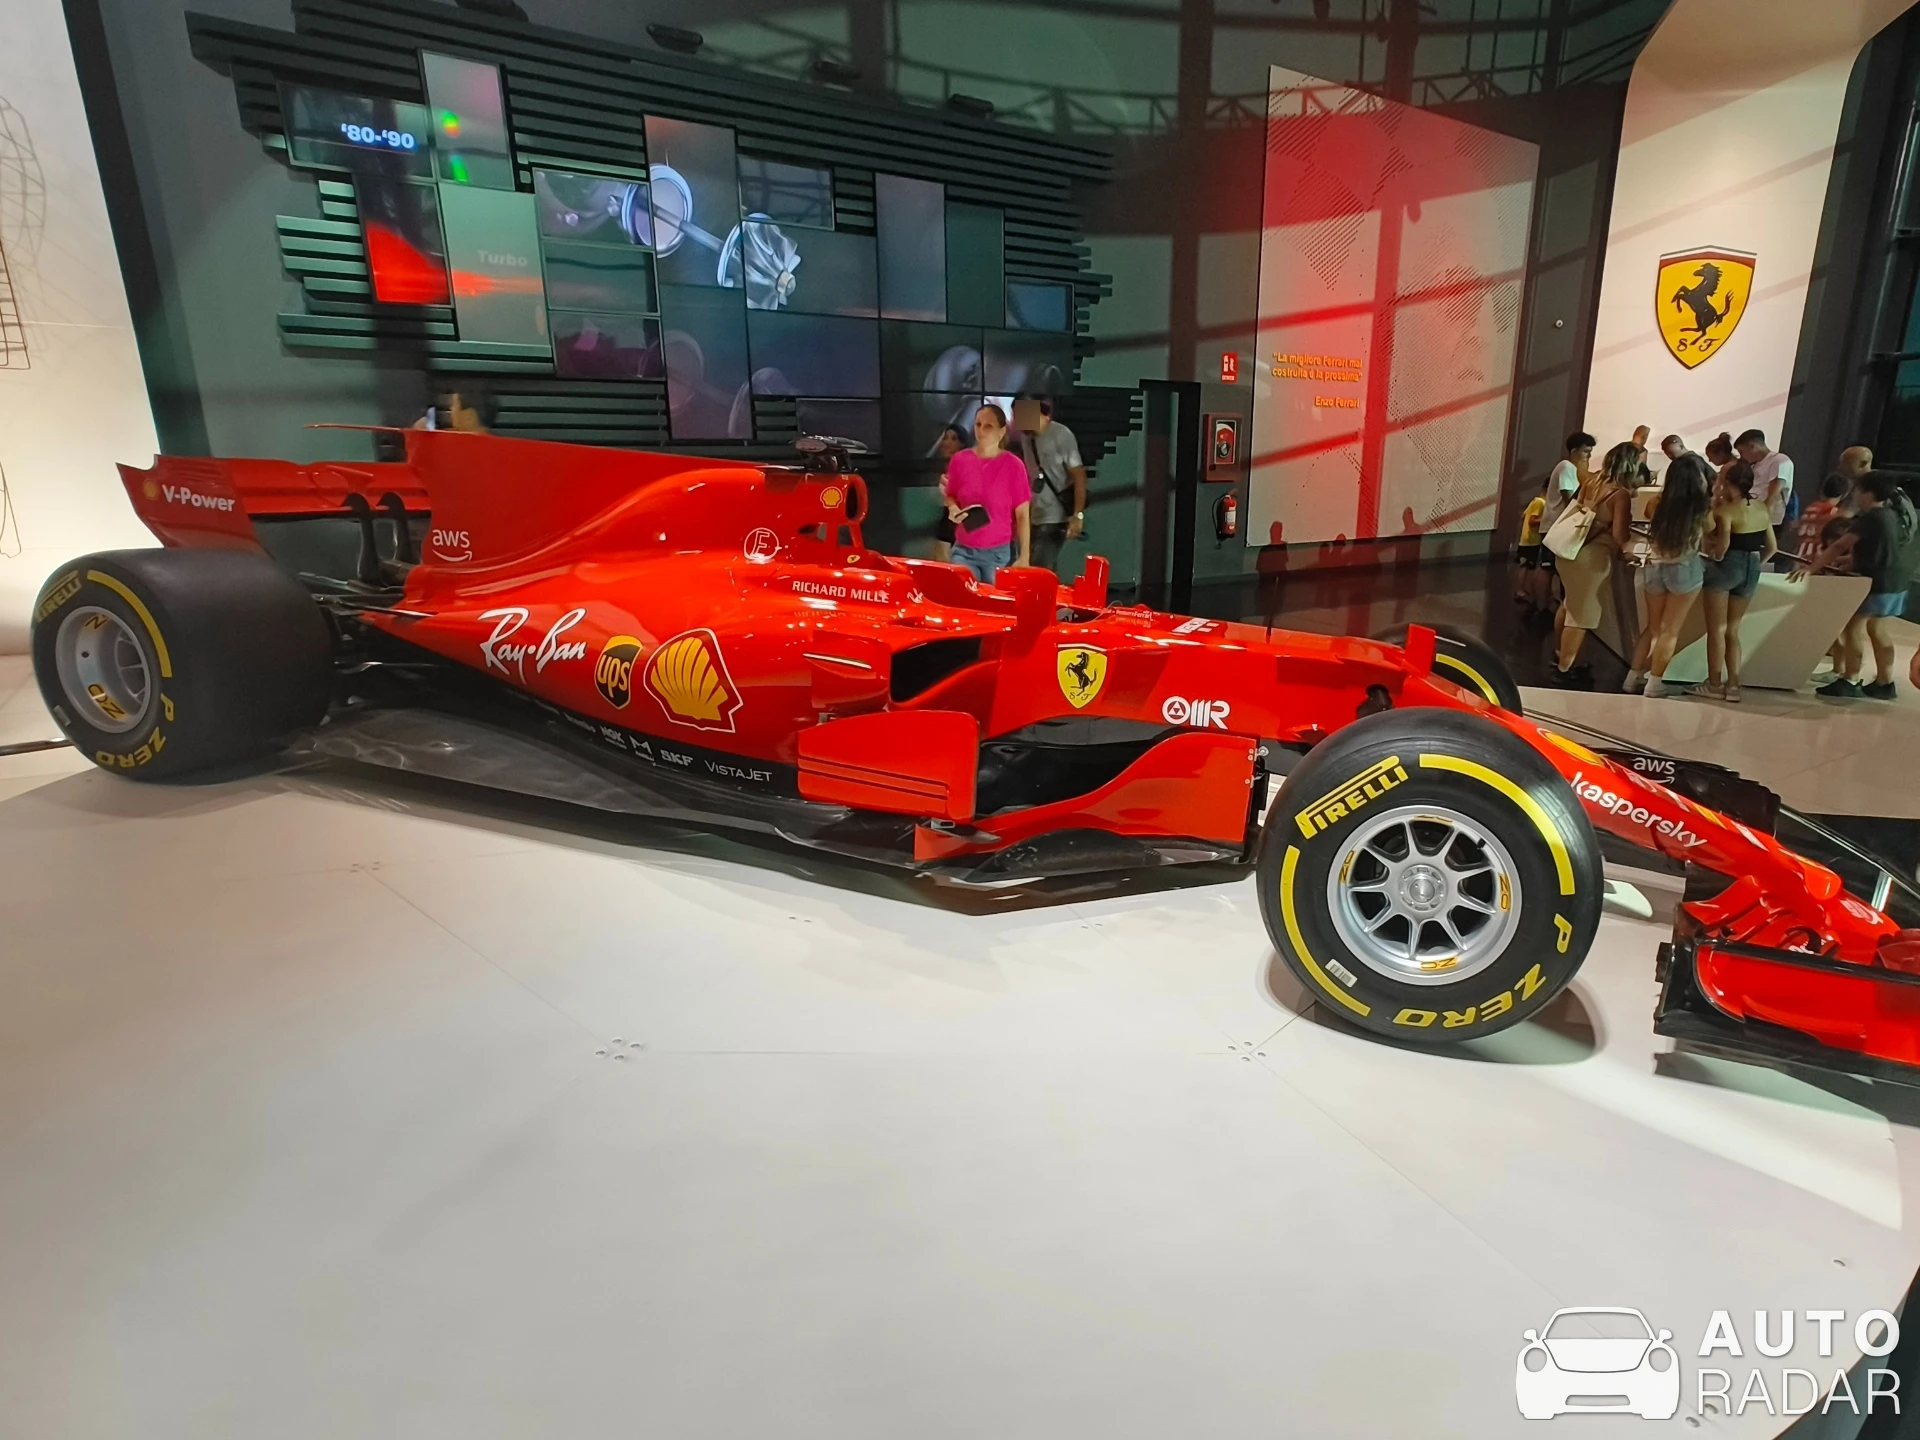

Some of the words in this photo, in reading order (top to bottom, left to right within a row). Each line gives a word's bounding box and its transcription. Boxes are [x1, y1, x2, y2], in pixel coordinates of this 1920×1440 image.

[477, 249, 528, 267] Turbo
[1272, 367, 1307, 379] costruita
[1289, 353, 1322, 366] migliore
[1323, 355, 1348, 368] Ferrari
[1315, 395, 1334, 407] Enzo
[1335, 396, 1360, 408] Ferrari
[162, 484, 235, 512] V-Power
[432, 529, 471, 549] aws
[792, 580, 847, 598] RICHARD
[850, 588, 890, 604] MILLE
[597, 654, 631, 699] ups
[160, 693, 175, 722] P
[95, 726, 167, 768] ZERO
[660, 749, 694, 766] SKF
[1631, 757, 1676, 775] aws
[1294, 755, 1409, 840] PIRELLI
[1570, 771, 1708, 848] kaspersky
[1553, 913, 1573, 954] P
[1392, 963, 1547, 1029] ZERO
